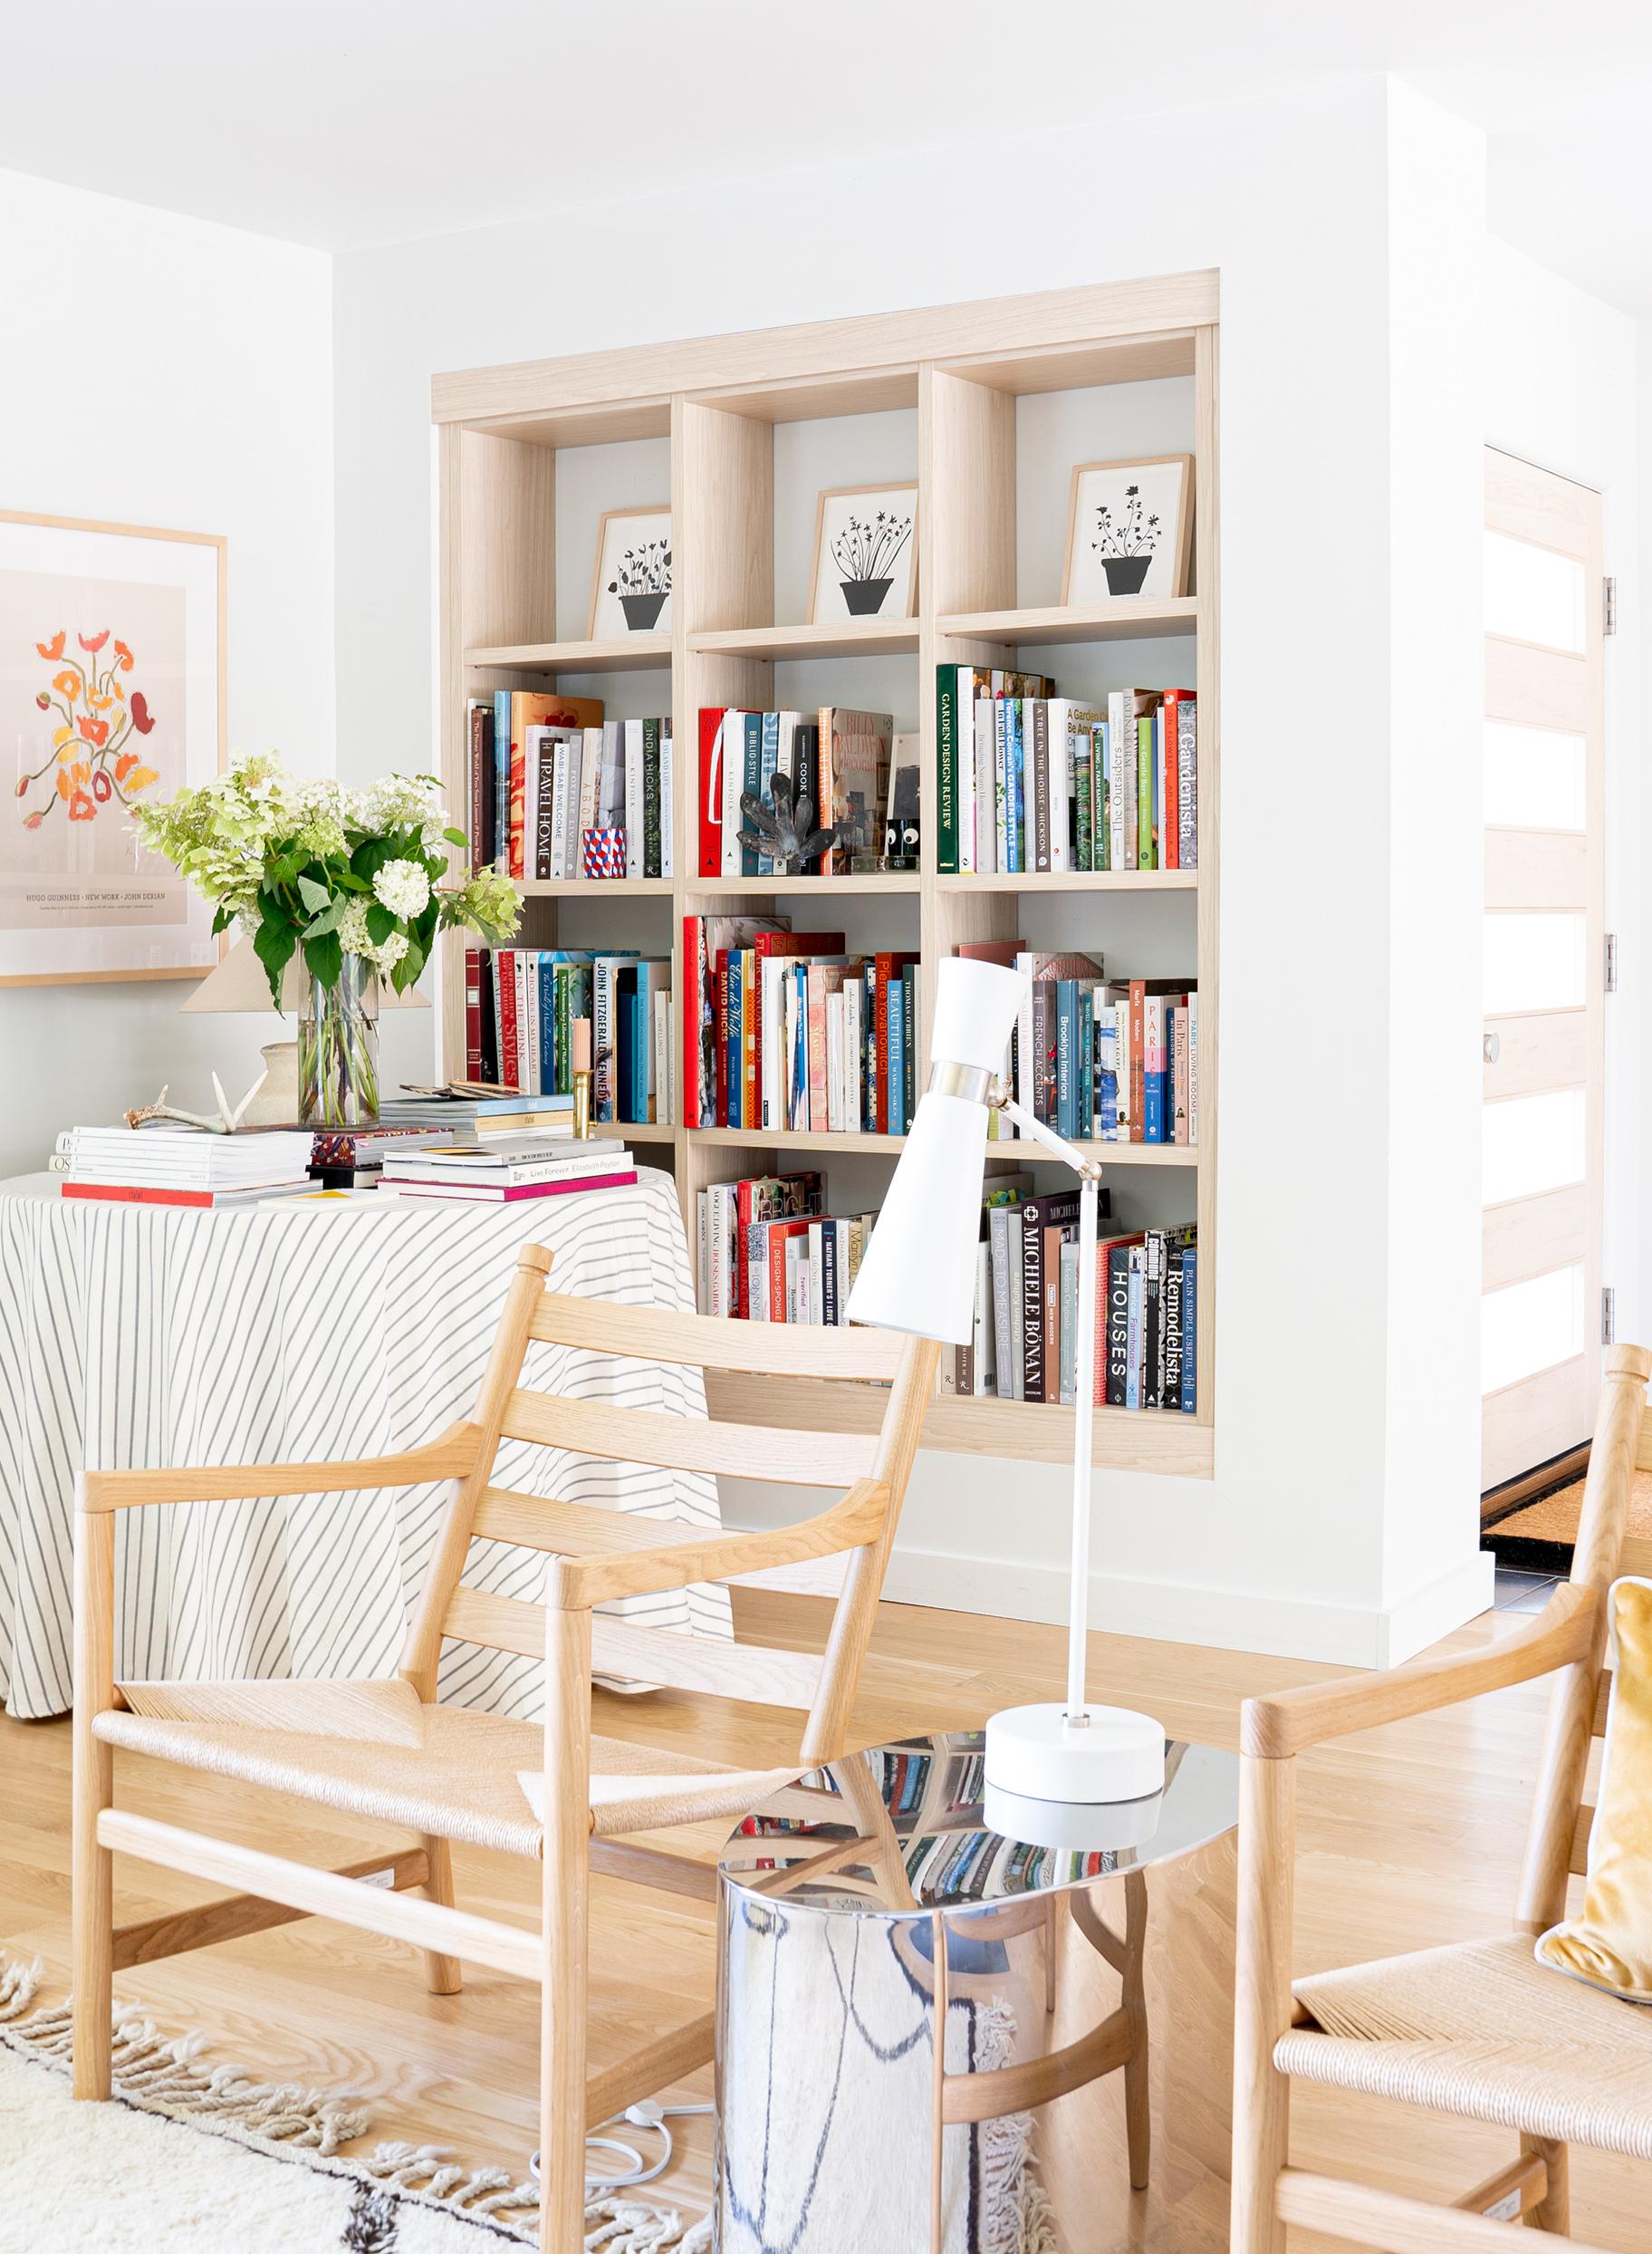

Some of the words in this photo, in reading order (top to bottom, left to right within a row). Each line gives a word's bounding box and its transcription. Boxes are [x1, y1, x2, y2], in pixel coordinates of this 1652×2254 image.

[847, 713, 874, 736] BILLY
[941, 694, 950, 740] GARDEN
[1005, 701, 1013, 733] Terence
[1024, 704, 1032, 743] PATINA
[1068, 722, 1076, 734] Be
[1167, 712, 1174, 725] ON
[645, 729, 654, 760] INDIA
[977, 734, 986, 765] Bringing
[1006, 736, 1014, 773] Conran's
[1037, 741, 1044, 751] IN
[942, 744, 951, 783] DESIGN
[978, 766, 986, 790] Nature
[540, 756, 552, 809] TRAVEL
[569, 769, 577, 814] FOXFIRE
[646, 764, 654, 800] HICKS
[1007, 774, 1015, 815] GARDEN
[1179, 733, 1196, 839] Gardenista
[942, 786, 951, 829] REVIEW
[538, 813, 551, 861] HOME
[567, 820, 575, 858] LIVING
[1038, 813, 1046, 852] HICKSON
[101, 892, 120, 901] WORK
[502, 957, 508, 969] OF
[755, 939, 764, 972] FLAIR
[516, 976, 523, 989] IN
[543, 984, 551, 1004] World
[597, 963, 606, 990] JOHN
[728, 964, 741, 990] Elsie
[879, 960, 889, 999] Pierre
[729, 992, 740, 1004] de
[530, 1015, 536, 1026] IN
[531, 1028, 536, 1040] MY
[597, 994, 607, 1053] FITZGERALD
[727, 1005, 742, 1038] Wolfe
[879, 1001, 888, 1074] Yovanovitch
[1034, 1016, 1042, 1055] FRENCH
[1060, 1016, 1070, 1058] Brooklyn
[1177, 1019, 1186, 1029] In
[503, 1024, 519, 1081] Styles
[542, 1041, 550, 1065] Castaing
[812, 1026, 821, 1073] MAISON
[1177, 1033, 1186, 1056] Paris
[598, 1057, 608, 1103] KENNEDY
[1035, 1059, 1043, 1106] ACCENTS
[1060, 1060, 1070, 1101] Interiors
[530, 1169, 543, 1178] Live
[544, 1167, 569, 1176] Forever
[571, 1161, 600, 1172] Elizabeth
[600, 1160, 620, 1169] Peyton
[761, 1192, 821, 1224] BRIGHT
[825, 1241, 833, 1267] NATHAN
[850, 1230, 861, 1270] Marilyn
[994, 1228, 1006, 1267] MADE
[1148, 1238, 1159, 1280] commune
[740, 1262, 748, 1295] YOUNG
[995, 1269, 1006, 1287] TO
[1023, 1227, 1040, 1315] MICHELE
[1064, 1262, 1072, 1292] Modern
[1186, 1268, 1194, 1296] PLAIN
[1063, 1295, 1072, 1330] Originals
[1129, 1275, 1139, 1317] American
[996, 1291, 1009, 1351] MEASURE
[1013, 1313, 1022, 1343] Kitchen
[1111, 1271, 1128, 1376] HOUSES
[1166, 1269, 1184, 1386] Remodelista
[1186, 1299, 1194, 1332] SIMPLE
[1024, 1319, 1042, 1384] BÖNAN
[1129, 1317, 1138, 1369] Farmhouses
